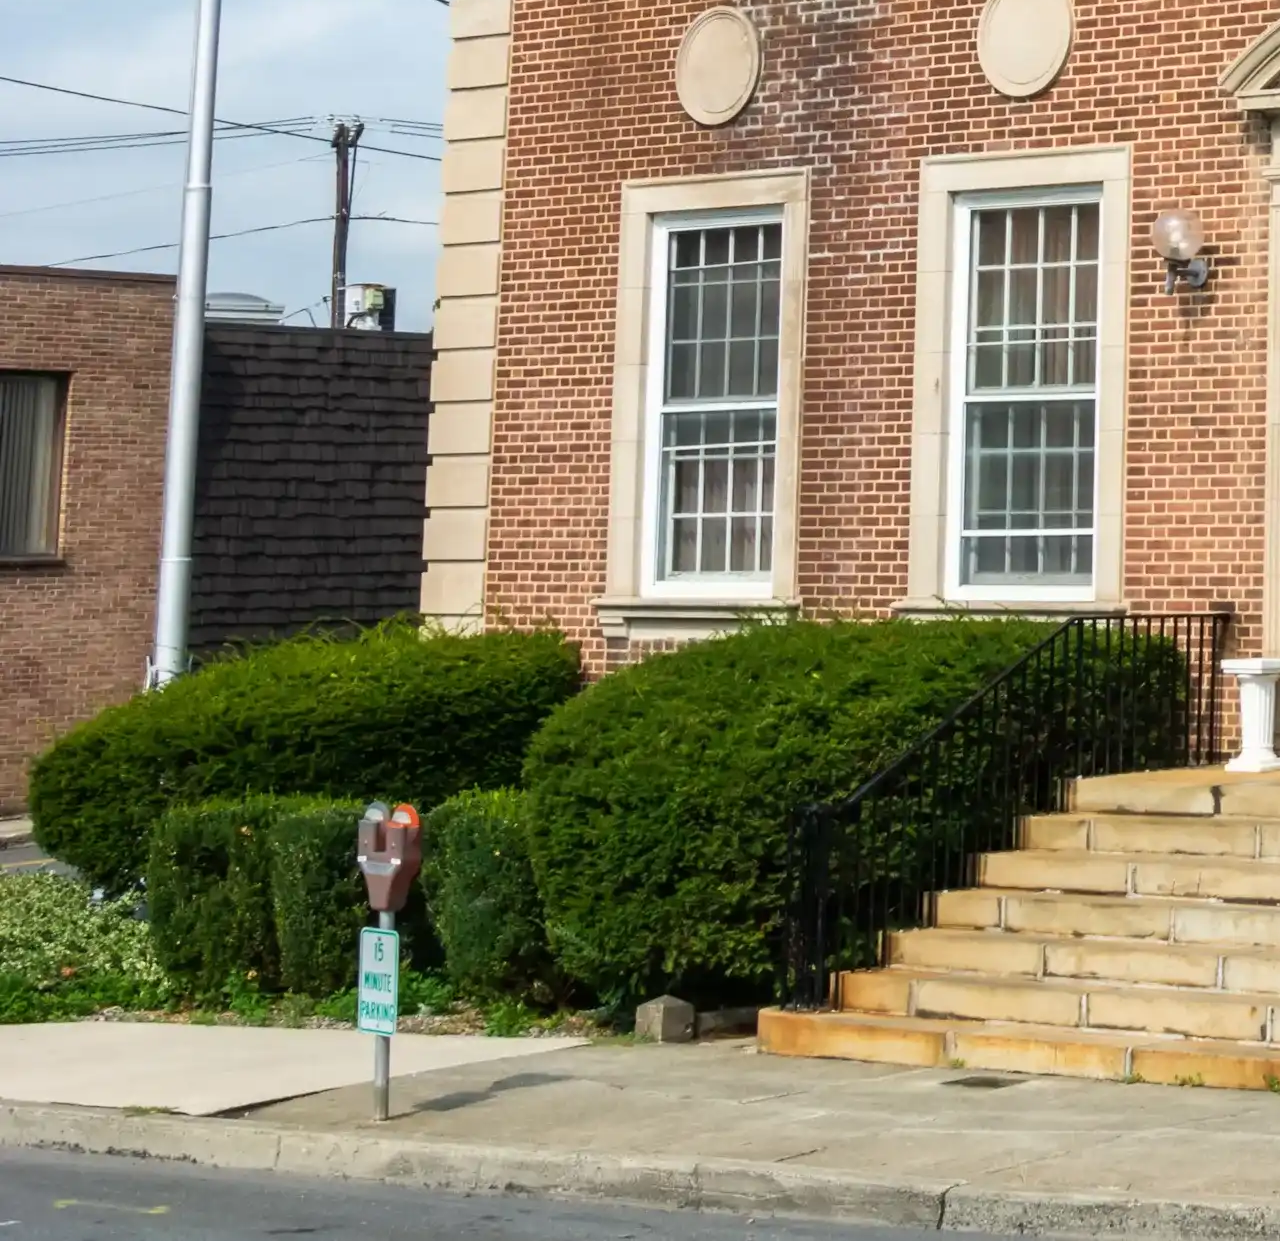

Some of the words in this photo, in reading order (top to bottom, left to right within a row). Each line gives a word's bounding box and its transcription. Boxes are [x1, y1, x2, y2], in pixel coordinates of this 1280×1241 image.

[374, 942, 384, 962] 15
[364, 971, 392, 993] MINUTE
[360, 999, 395, 1023] PARKING
